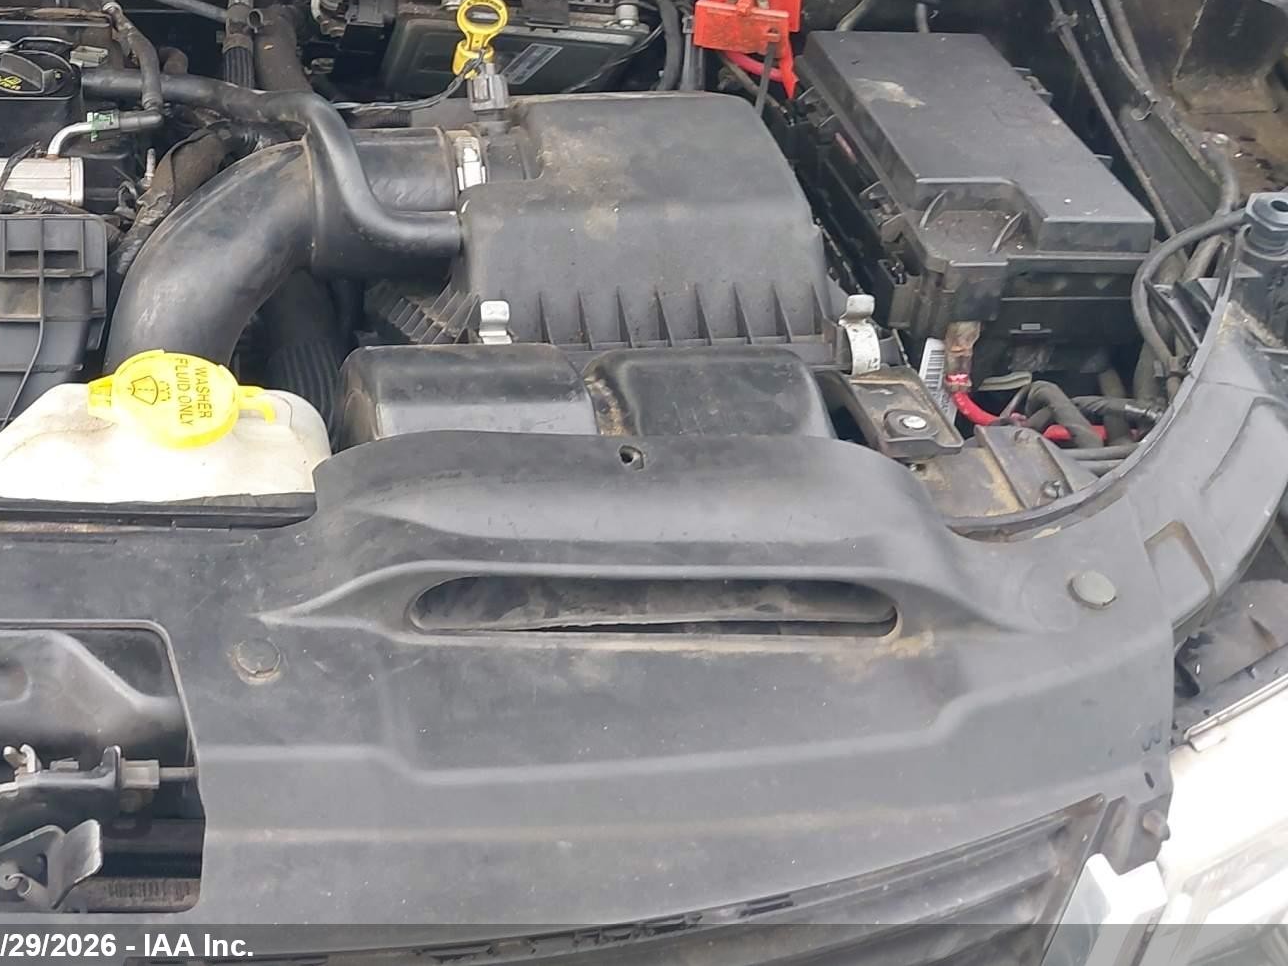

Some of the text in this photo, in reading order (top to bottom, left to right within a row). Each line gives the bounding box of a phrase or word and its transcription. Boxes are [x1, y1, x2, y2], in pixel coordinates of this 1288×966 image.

[175, 357, 194, 426] FLUID ONLY
[194, 366, 212, 419] WASHER
